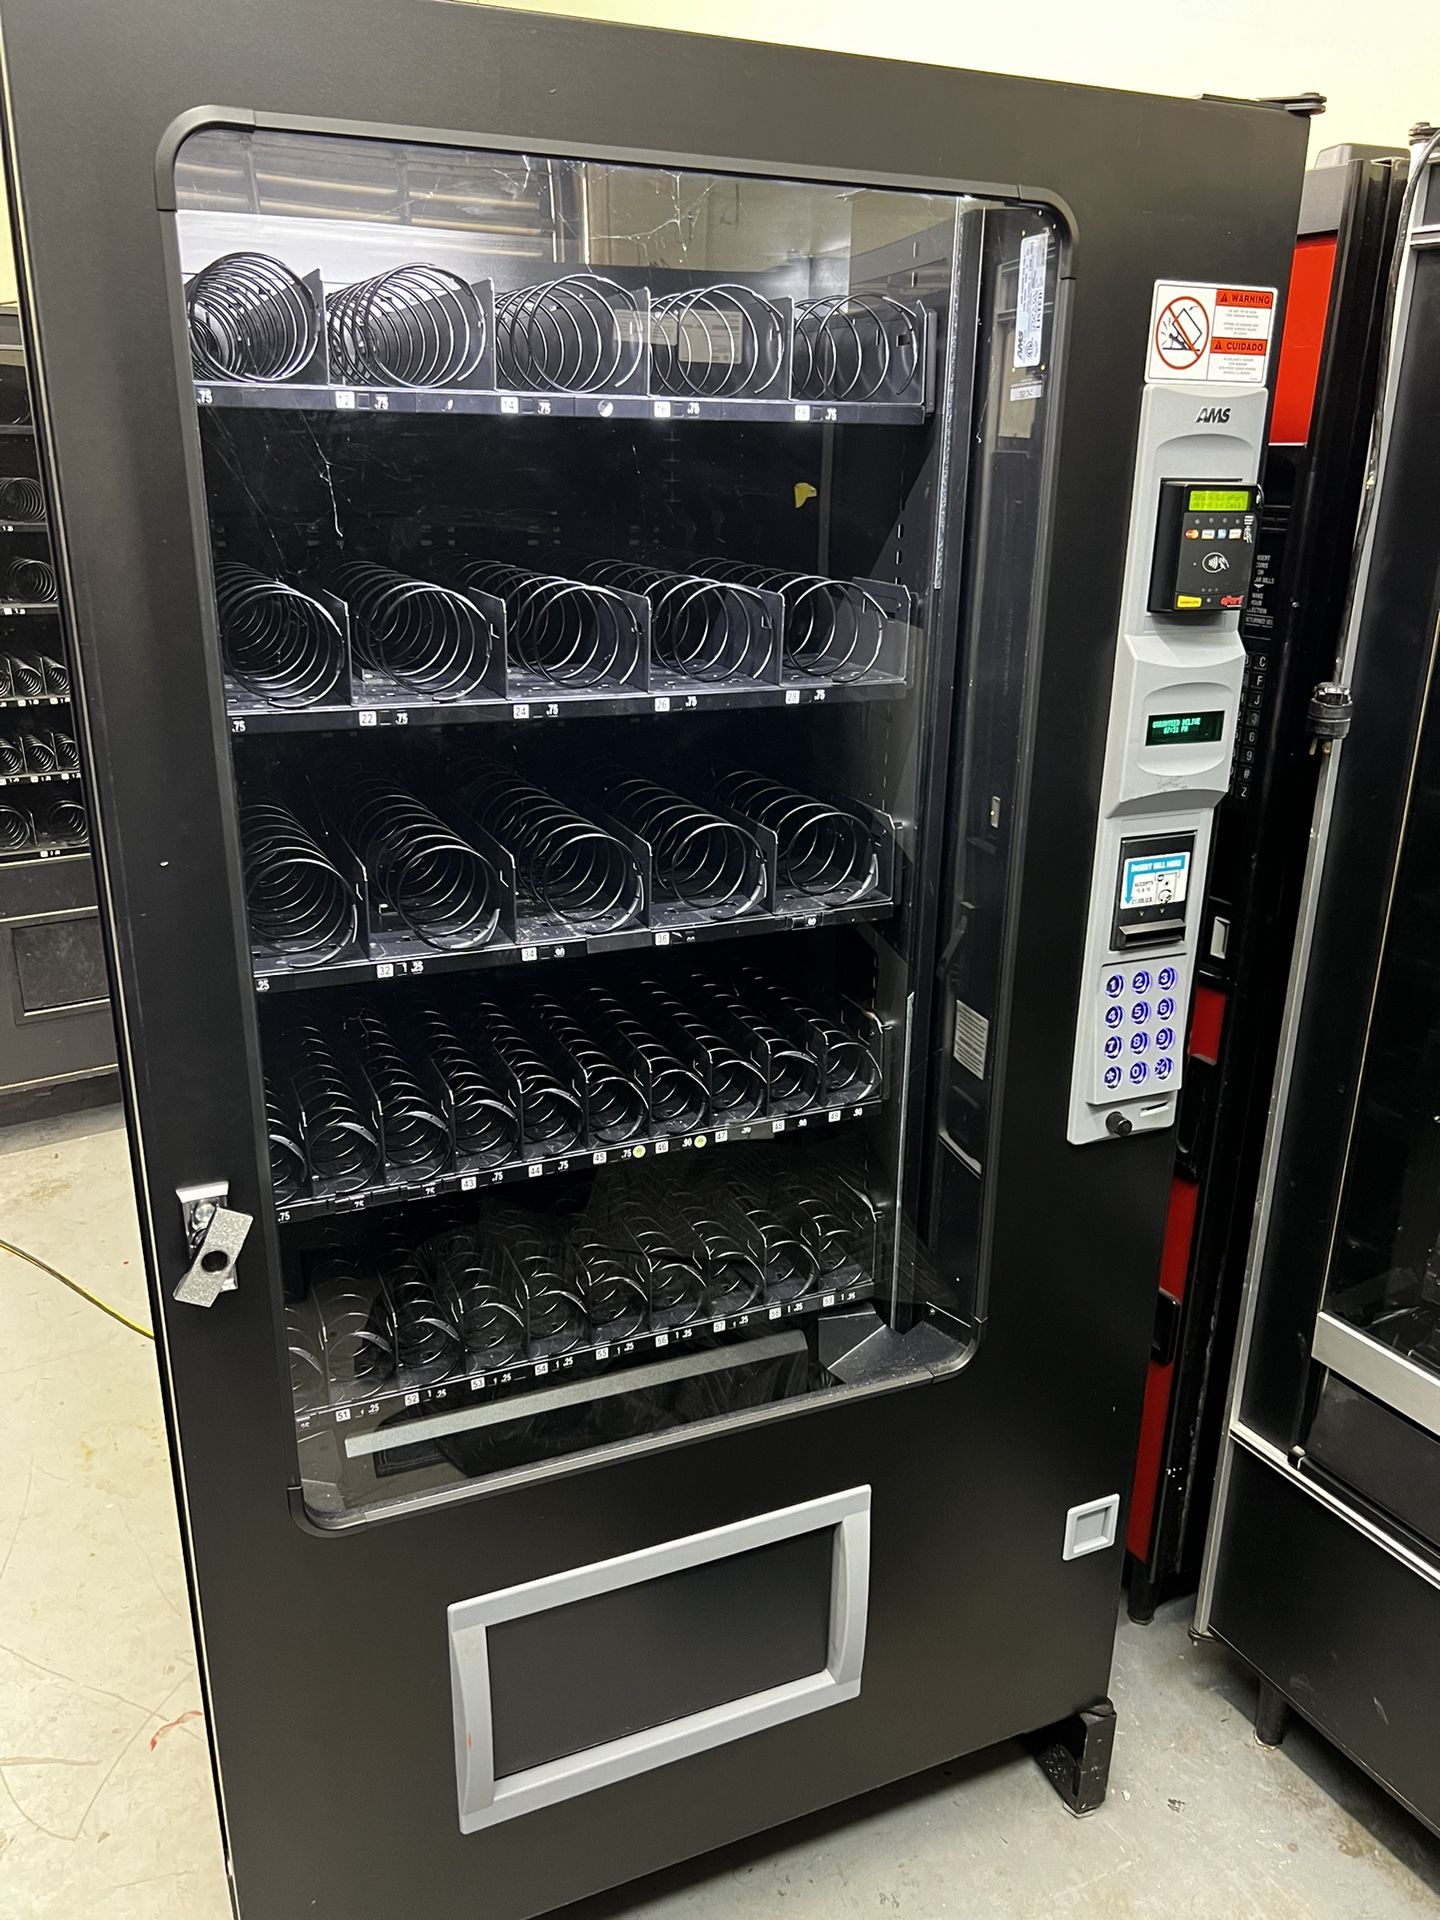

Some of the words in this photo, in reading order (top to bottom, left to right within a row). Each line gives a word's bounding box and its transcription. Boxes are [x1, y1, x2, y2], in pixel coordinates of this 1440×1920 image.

[1231, 293, 1270, 304] WARNING
[1226, 342, 1263, 352] CUIDADO
[1195, 407, 1231, 424] AMS
[1259, 656, 1266, 667] C
[1256, 675, 1263, 686] F
[787, 692, 798, 703] 28
[1254, 694, 1261, 705] J
[656, 699, 668, 710] 26
[515, 705, 527, 717] 24
[360, 713, 374, 724] 22
[395, 713, 408, 725] .75
[231, 720, 246, 733] .75
[1248, 731, 1255, 742] 6
[1246, 750, 1253, 761] 9
[657, 934, 668, 944] 36
[523, 949, 535, 959] 34
[379, 965, 391, 976] 32
[716, 1132, 726, 1141] 47
[657, 1143, 667, 1152] 46
[594, 1153, 605, 1162] 45
[621, 1149, 632, 1159] .75
[530, 1166, 541, 1175] 44
[557, 1160, 569, 1170] .75
[463, 1178, 475, 1189] 43
[492, 1172, 503, 1182] .75
[277, 1211, 290, 1222] .75
[824, 1296, 834, 1305] 59
[770, 1308, 780, 1318] 58
[715, 1321, 724, 1331] 57
[657, 1336, 667, 1345] 56
[597, 1349, 608, 1358] 55
[536, 1364, 547, 1374] 54
[472, 1379, 483, 1389] 53
[406, 1394, 418, 1404] 52
[337, 1410, 349, 1420] 51
